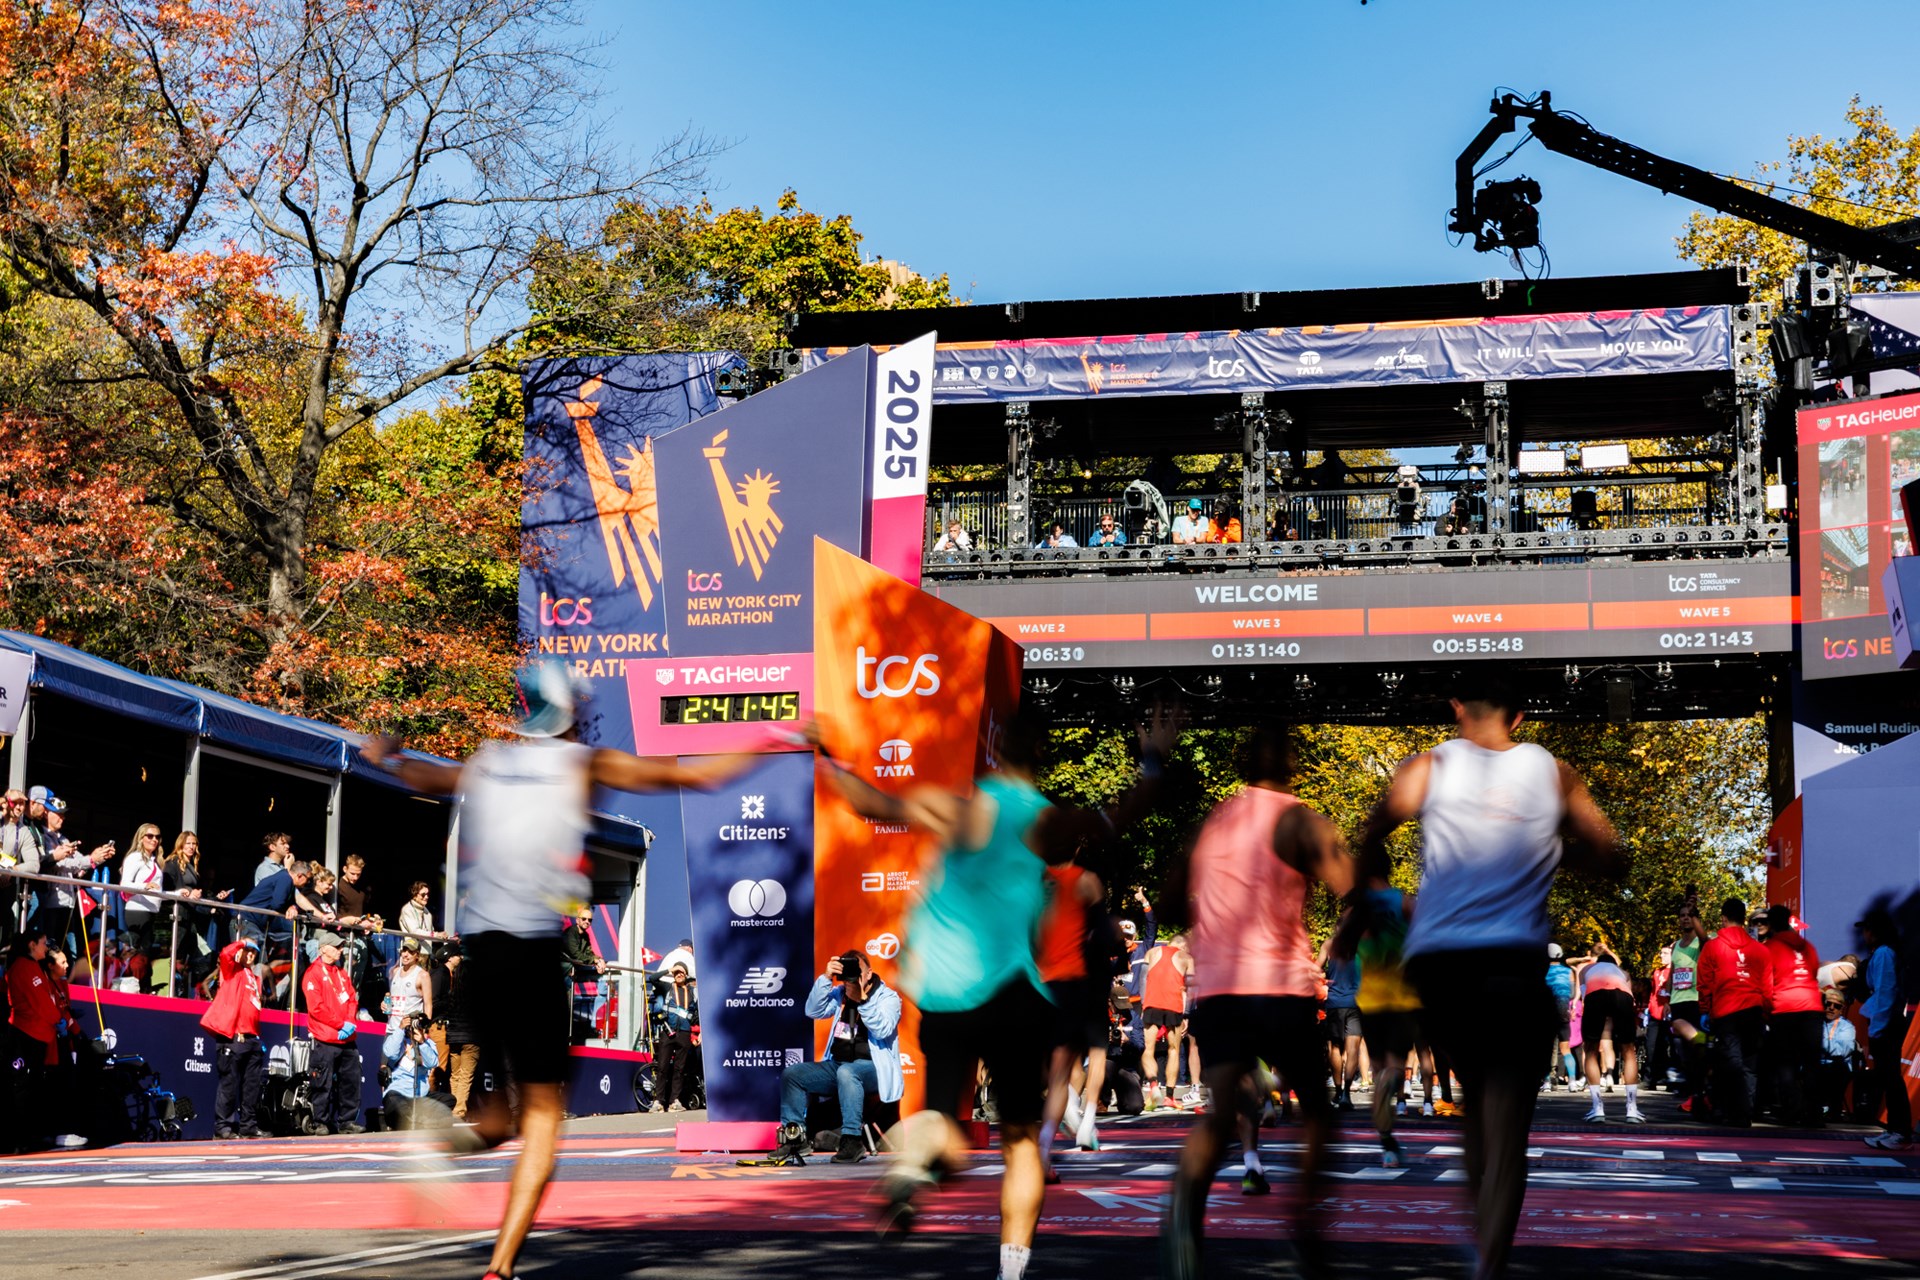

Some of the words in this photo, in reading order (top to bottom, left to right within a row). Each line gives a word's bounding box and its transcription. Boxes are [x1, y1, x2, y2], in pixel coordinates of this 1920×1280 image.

[1477, 348, 1492, 360] IT
[1493, 347, 1534, 359] WILL
[1601, 341, 1646, 355] MOVE
[1651, 340, 1684, 351] YOU
[1209, 356, 1246, 379] tcs
[1296, 367, 1324, 376] TATA
[884, 369, 921, 480] 2025
[687, 569, 723, 593] tcs
[1668, 574, 1698, 593] tcs
[1195, 584, 1318, 604] WELCOME
[540, 591, 593, 626] tcs
[687, 597, 723, 610] NEW
[726, 595, 766, 609] YORK
[768, 594, 802, 608] CITY
[687, 611, 773, 626] MARATHON
[1452, 613, 1492, 623] WAVE
[1494, 613, 1503, 622] 4
[1680, 607, 1720, 618] WAVE
[1723, 607, 1731, 616] 5
[1018, 624, 1055, 634] WAVE
[1058, 623, 1065, 633] 2
[1233, 619, 1271, 629] WAVE
[1274, 618, 1281, 628] 3
[538, 635, 593, 655] NEW
[597, 633, 658, 653] YORK
[1432, 637, 1524, 653] 00:55:48
[1660, 631, 1753, 648] 00:21:43
[1212, 642, 1301, 658] 01:31:40
[1823, 637, 1858, 660] tcs
[1864, 636, 1893, 657] NE
[856, 645, 941, 699] tcs
[1824, 722, 1877, 735] Samuel
[1879, 722, 1920, 734] Rudin
[1834, 742, 1868, 755] Jack
[873, 765, 915, 778] TATA
[719, 825, 787, 841] Citizens
[874, 825, 909, 834] FAMILY
[730, 918, 785, 927] mastercard
[726, 999, 748, 1008] new
[750, 997, 795, 1007] balance
[735, 1050, 782, 1058] UNITED
[184, 1059, 212, 1074] Citizens
[722, 1059, 782, 1067] AIRLINES
